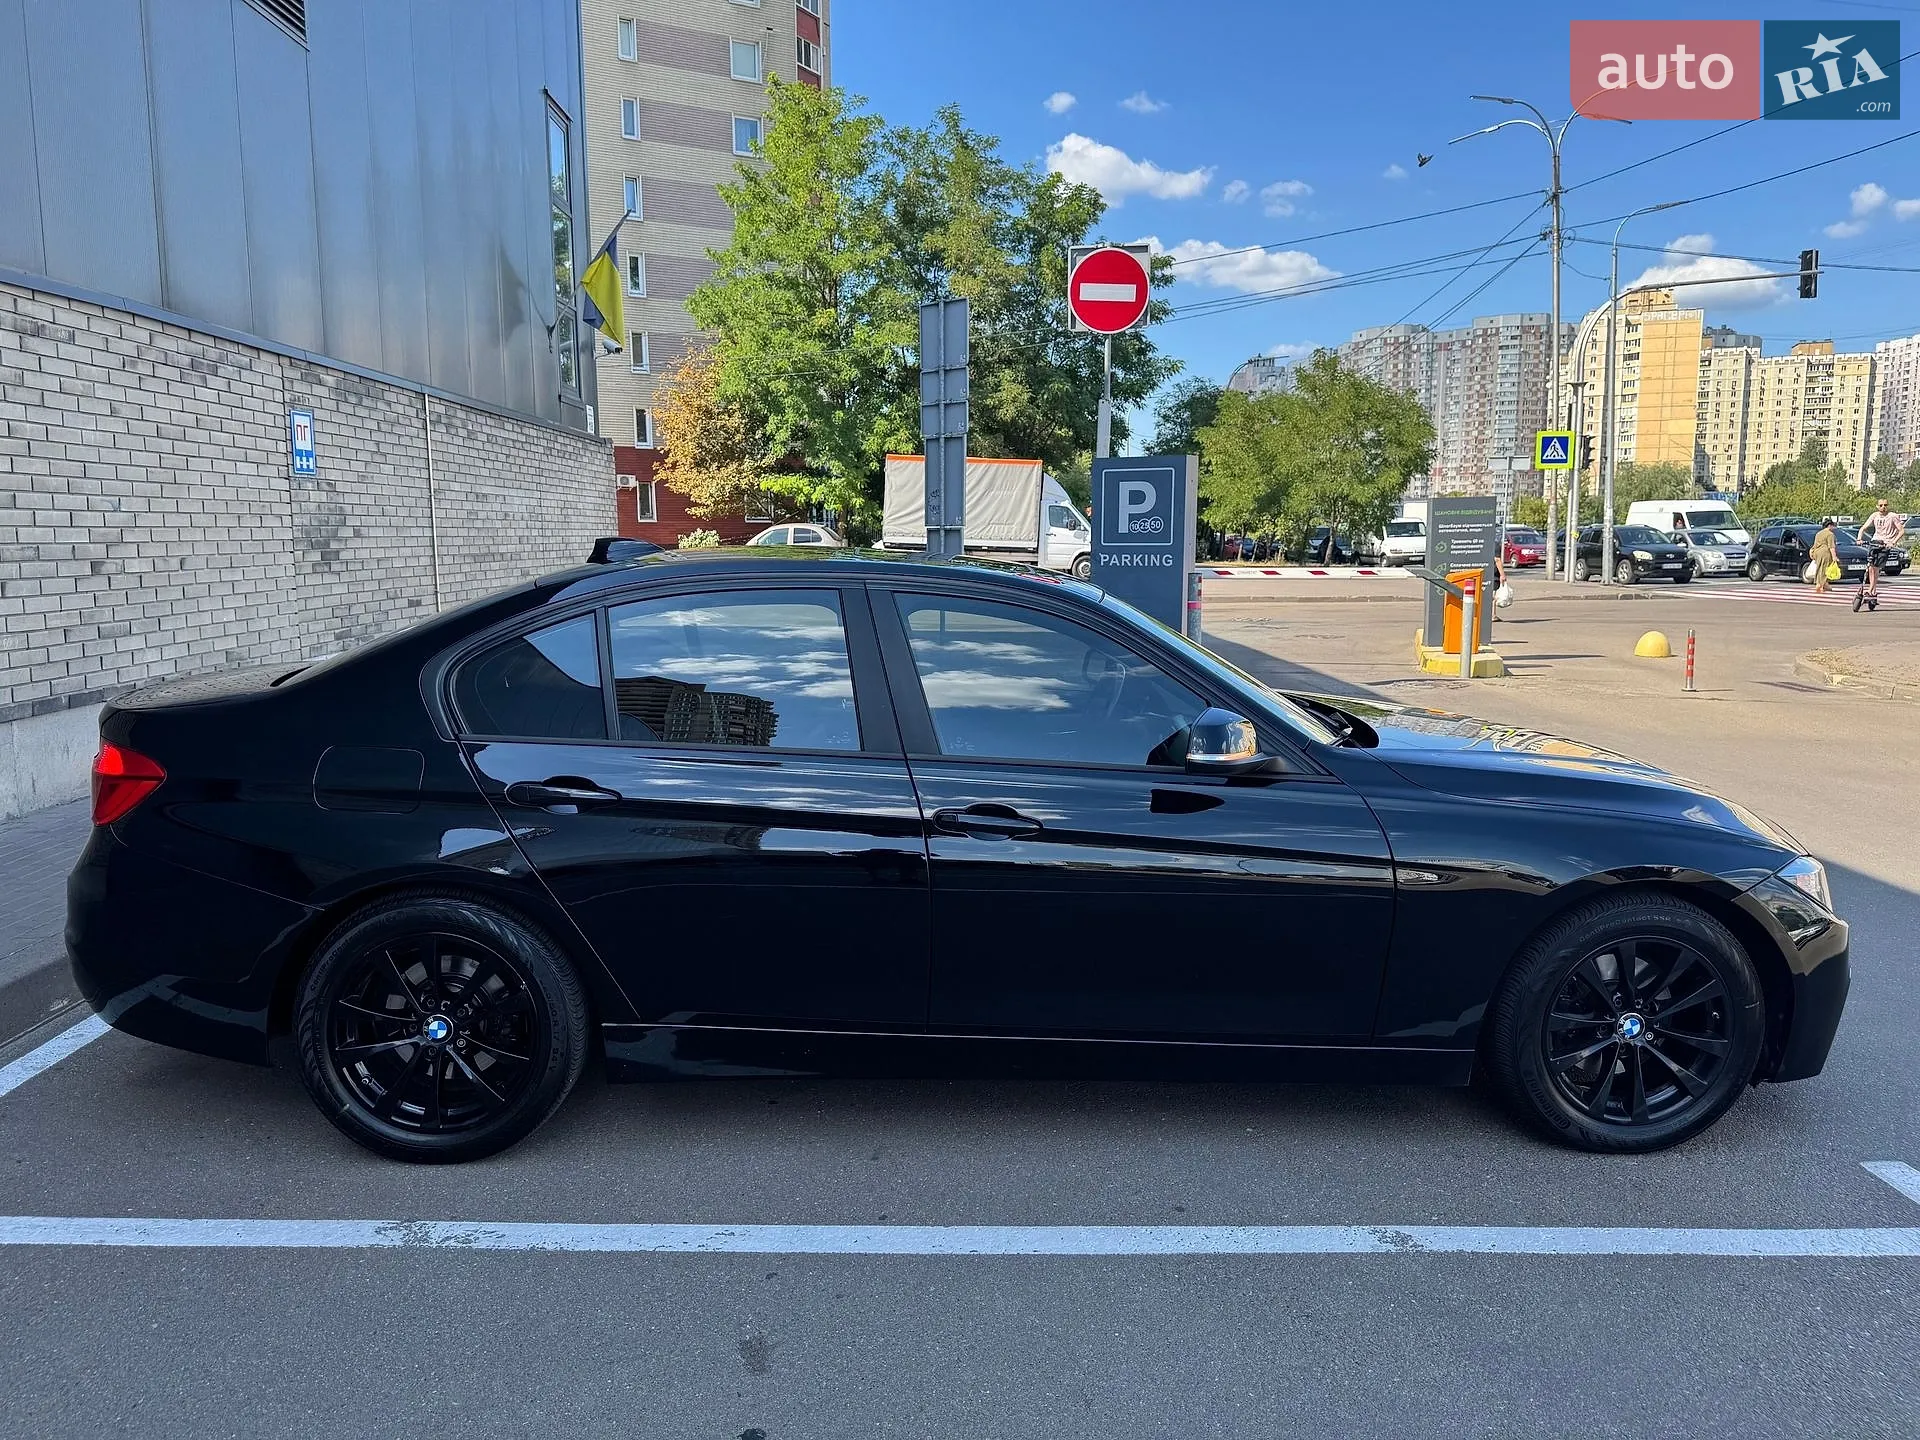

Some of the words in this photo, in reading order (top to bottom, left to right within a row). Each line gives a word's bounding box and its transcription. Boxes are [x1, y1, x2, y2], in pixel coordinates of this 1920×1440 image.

[1118, 481, 1157, 534] P
[1150, 520, 1161, 529] 50
[1100, 554, 1174, 567] PARKING
